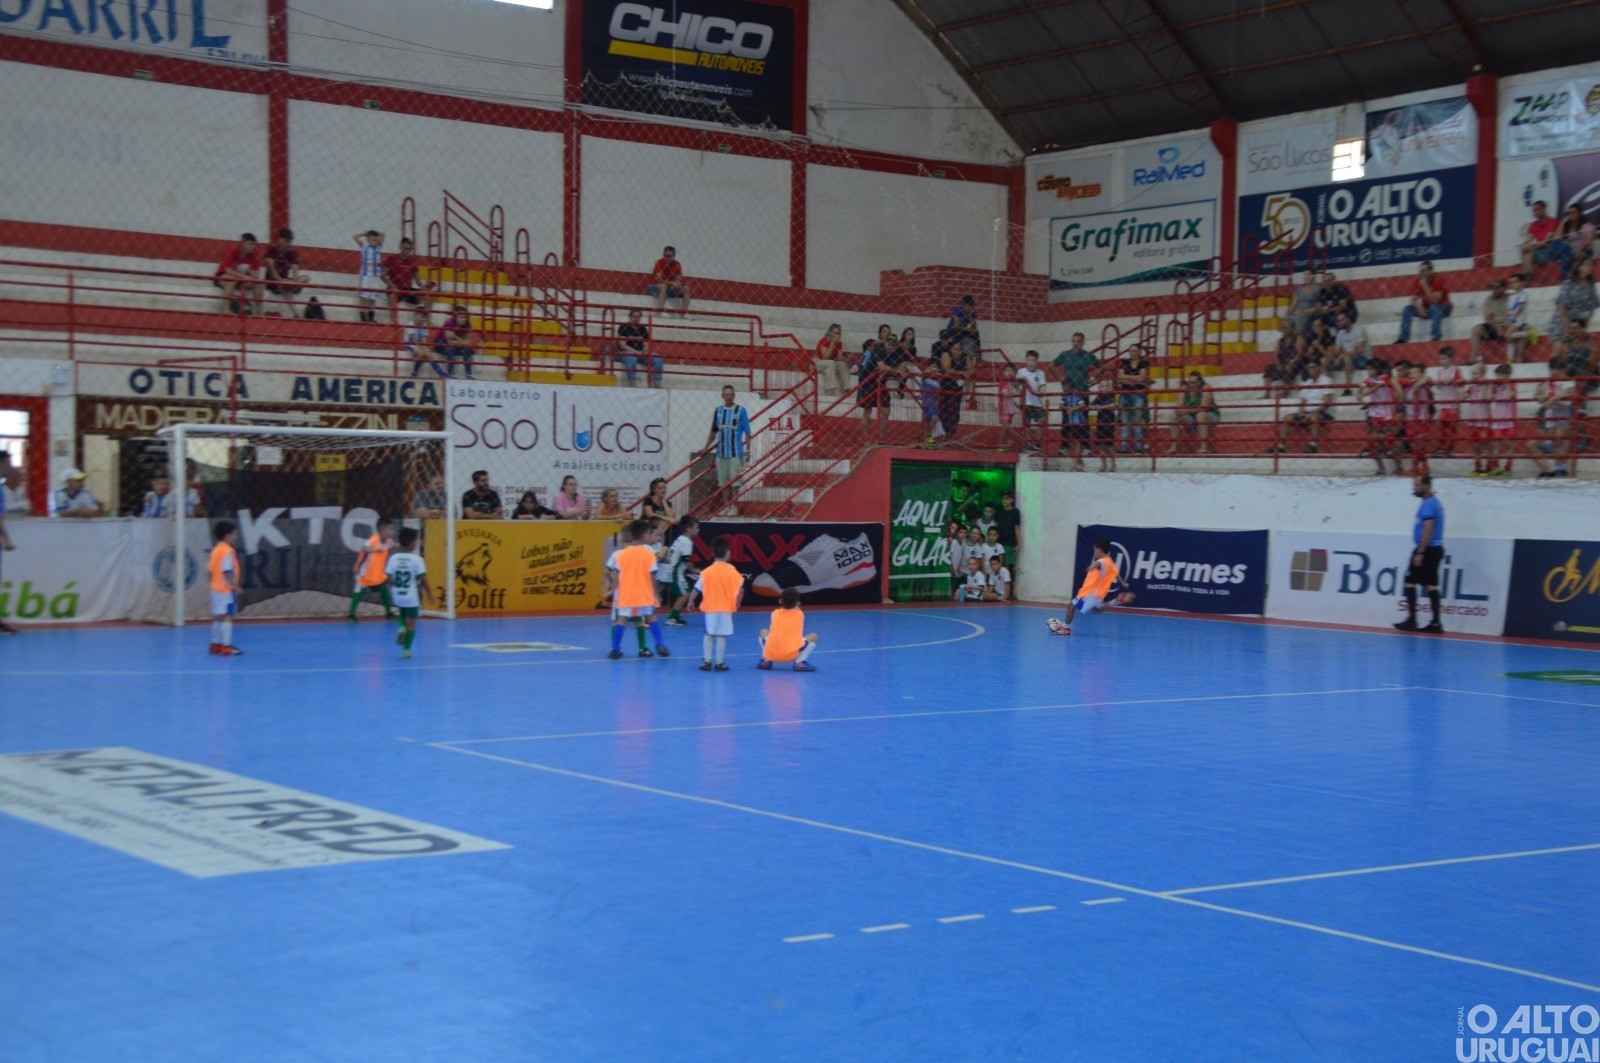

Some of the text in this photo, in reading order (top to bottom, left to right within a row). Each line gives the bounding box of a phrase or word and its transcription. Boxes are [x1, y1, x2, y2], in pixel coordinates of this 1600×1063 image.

[608, 2, 774, 60] CHICO
[1132, 160, 1206, 186] RaiMed
[1328, 178, 1443, 220] O ALTO
[1061, 217, 1203, 263] Grafimax
[1314, 212, 1443, 248] URUGUAI
[291, 375, 440, 407] AMERICA
[451, 385, 541, 400] Laboratório
[451, 391, 664, 453] São Lucas
[553, 459, 662, 472] Análises clínicas
[893, 499, 949, 527] AQUI
[237, 505, 383, 556] KTO
[833, 541, 869, 562] MAX
[837, 550, 872, 570] 1000
[1132, 550, 1248, 584] Hermes
[541, 567, 587, 583] CHOPP
[1333, 551, 1489, 601] BaiL
